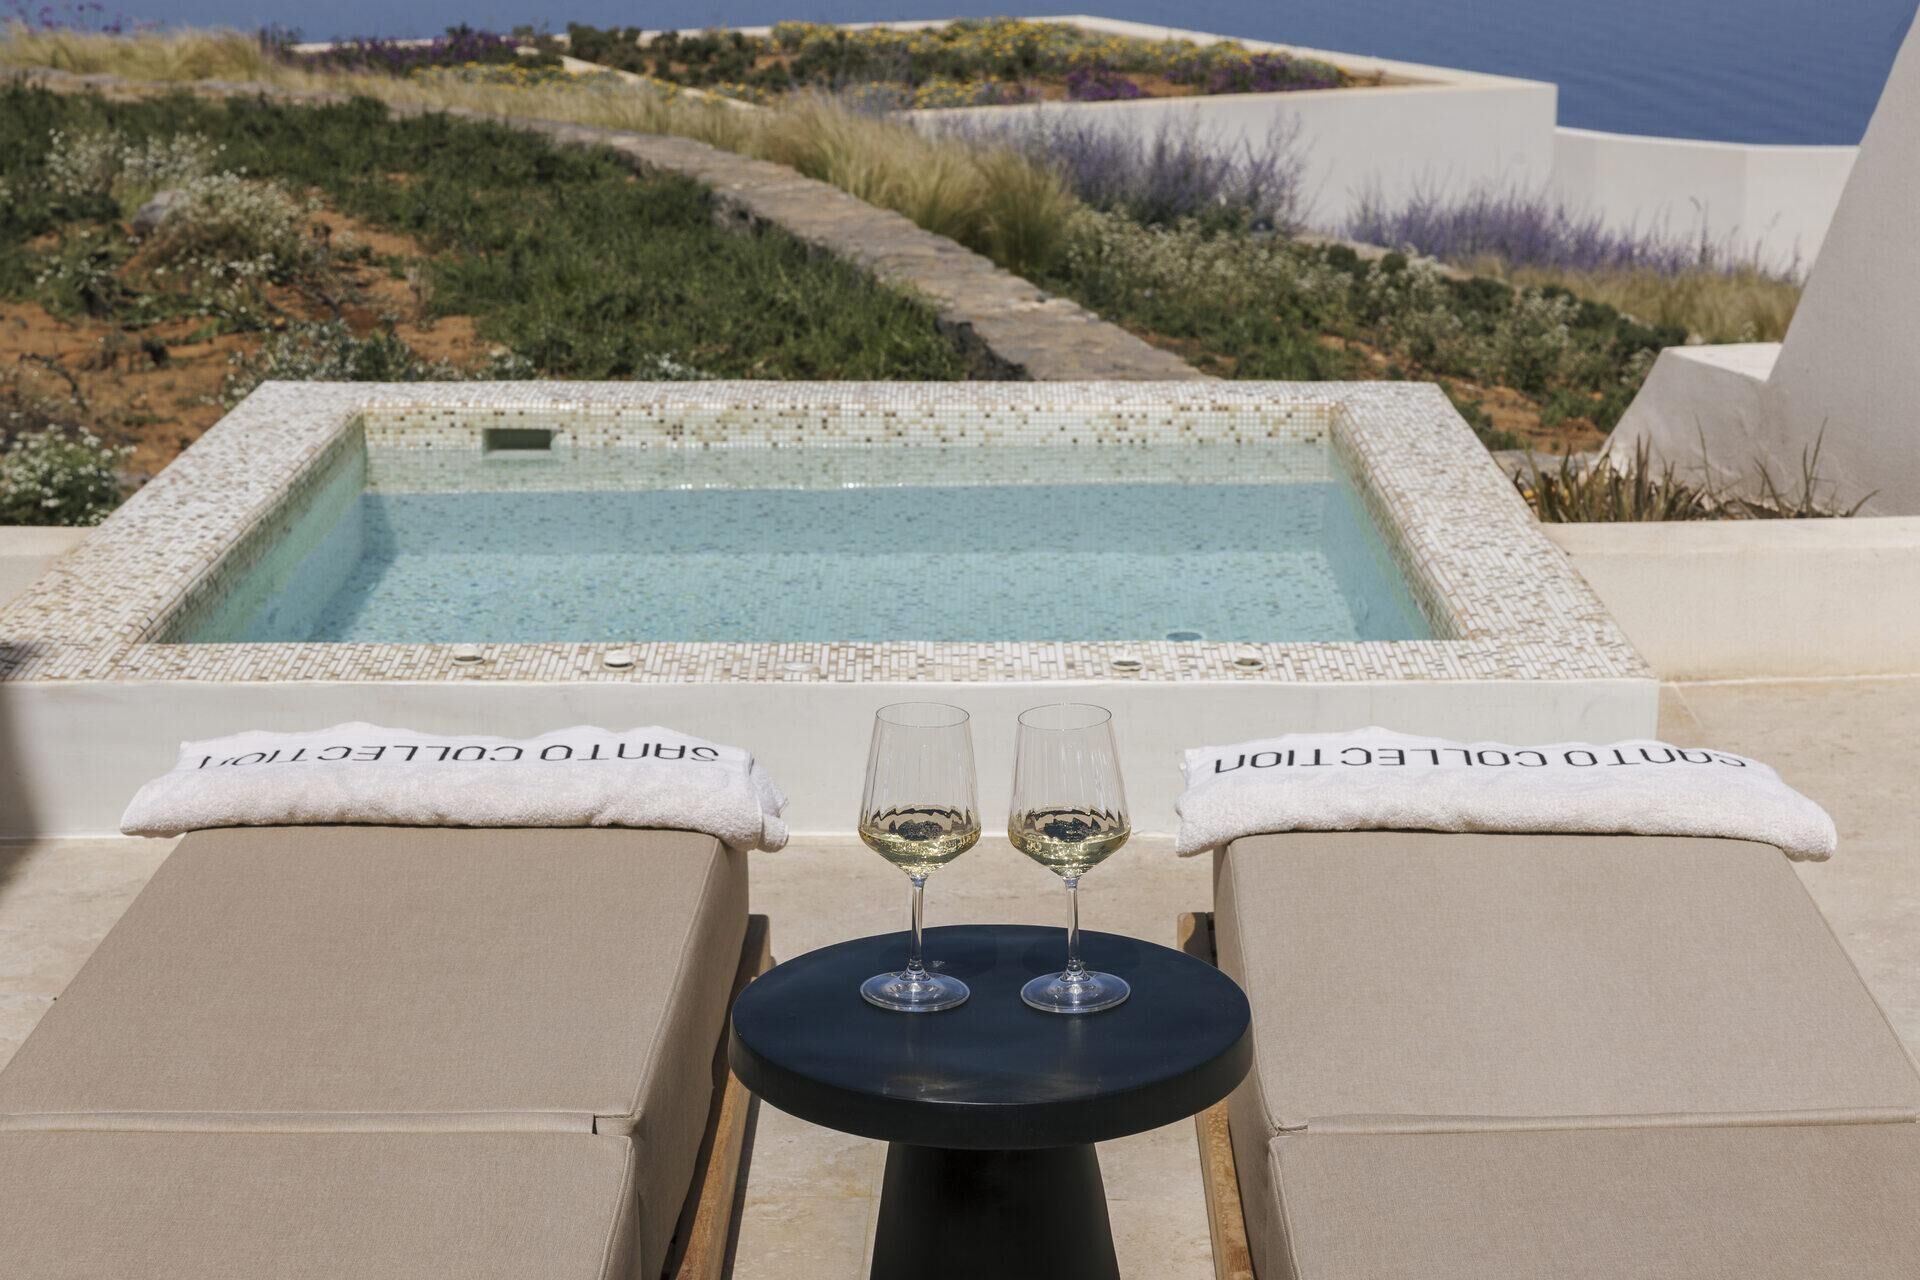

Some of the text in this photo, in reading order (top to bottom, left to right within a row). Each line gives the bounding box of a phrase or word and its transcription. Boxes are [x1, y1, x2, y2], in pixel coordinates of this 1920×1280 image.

[198, 743, 719, 769] SANTO COLLECTION
[1214, 747, 1548, 774] COLLECTION
